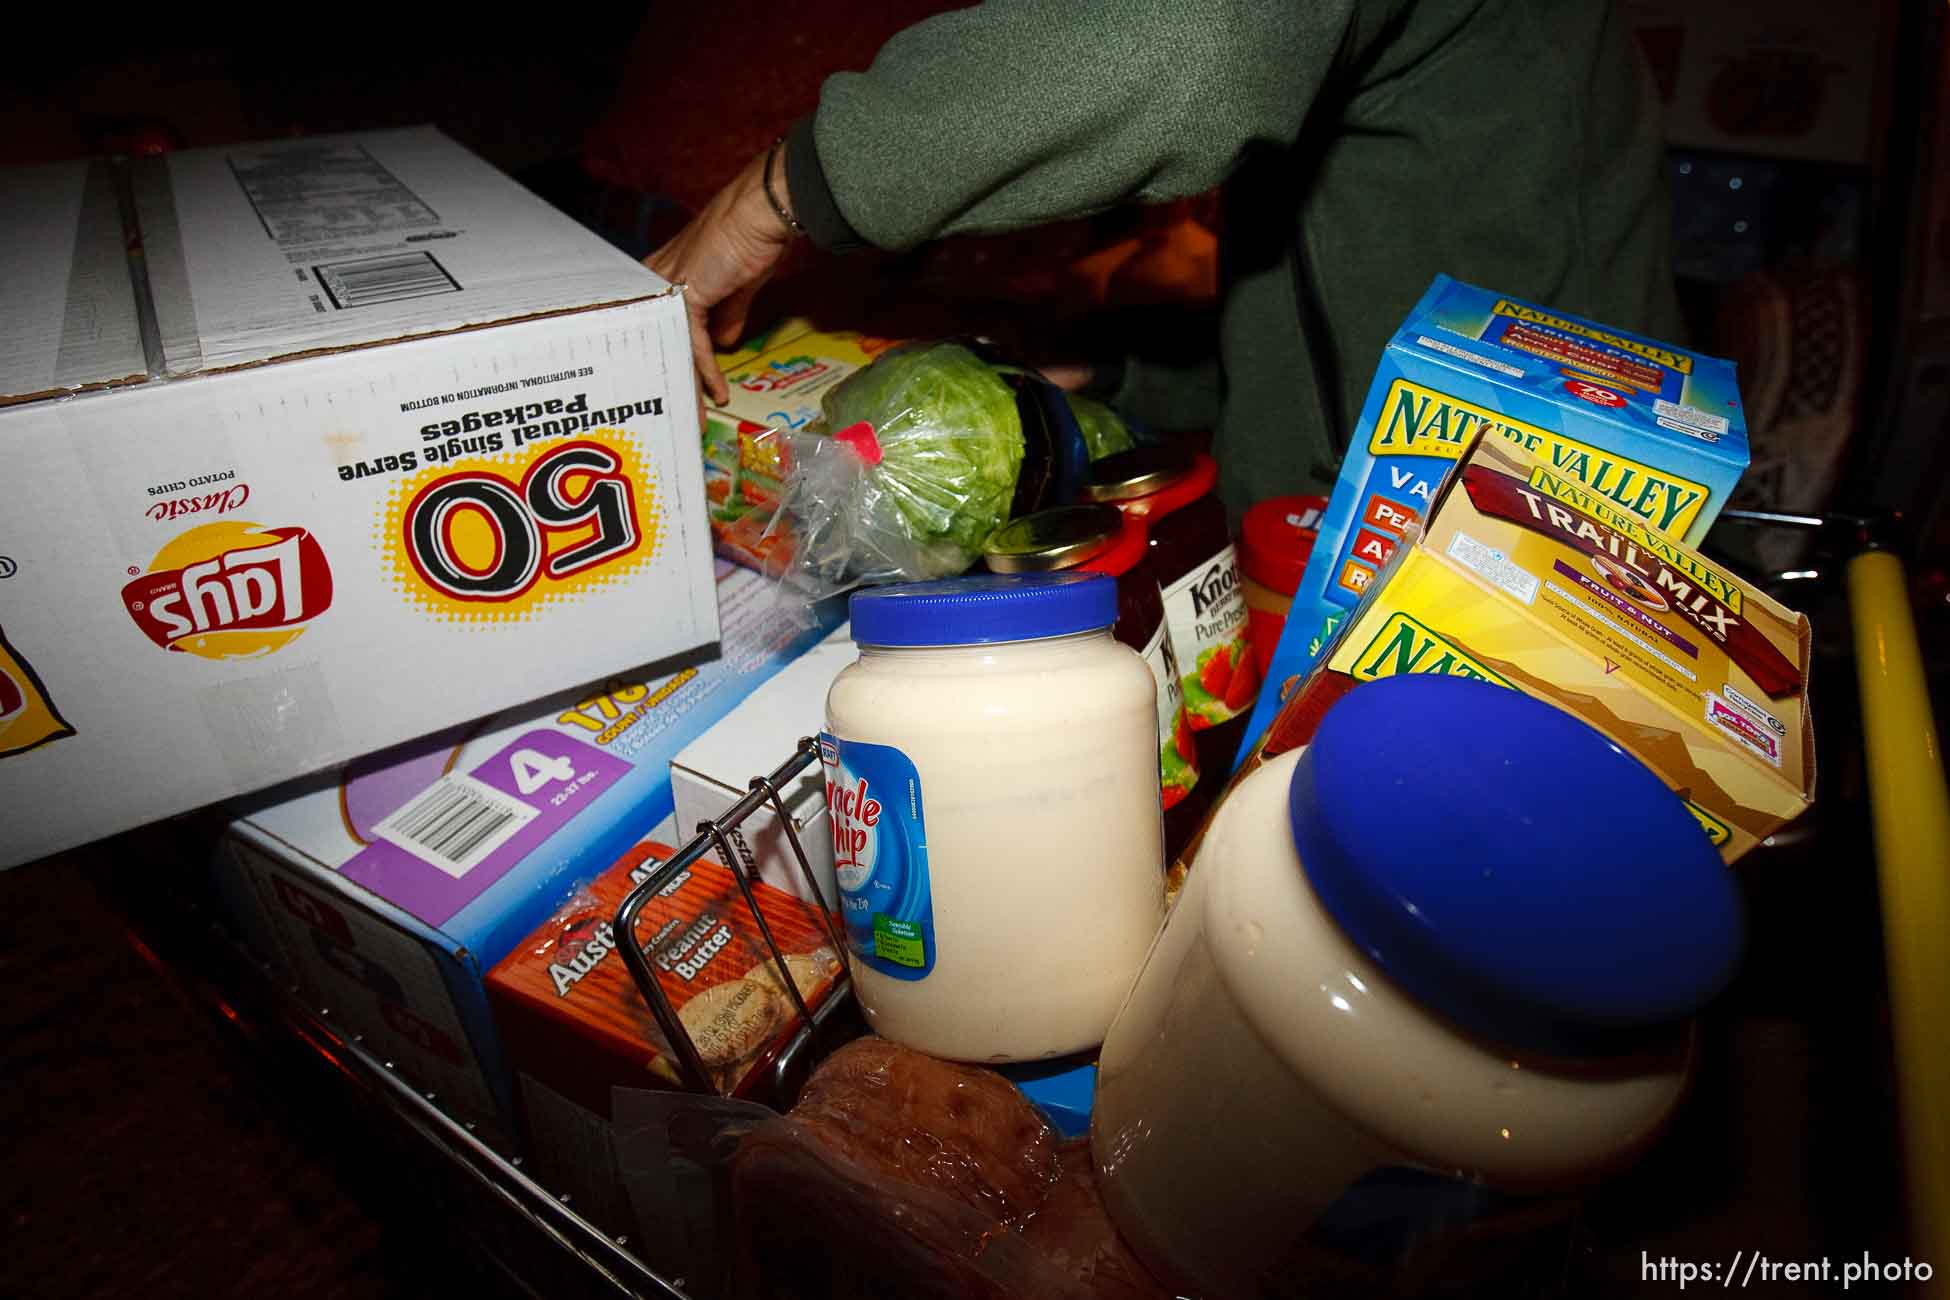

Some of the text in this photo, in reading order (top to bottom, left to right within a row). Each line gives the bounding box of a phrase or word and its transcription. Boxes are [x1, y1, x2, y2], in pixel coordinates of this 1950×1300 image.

[1501, 303, 1588, 335] NATURE
[1600, 329, 1686, 369] VALLEY
[400, 366, 594, 413] SEE NUTRITIONAL INFORMATION ON BOTTOM
[420, 393, 589, 442] Packages
[337, 397, 664, 482] Individual Single Serve
[145, 483, 250, 521] Classic
[147, 470, 236, 496] POTATO CHIPS
[1552, 444, 1699, 531] VALLEY
[403, 440, 642, 602] 50
[1537, 471, 1738, 607] NATURE VALLEY
[1516, 487, 1649, 577] TRAIL
[1656, 566, 1741, 637] MIX
[1193, 619, 1222, 640] Pure
[1579, 575, 1625, 606] FRUIT
[1641, 614, 1673, 637] NUT
[509, 748, 576, 796] 4
[830, 812, 867, 867] hip
[547, 917, 640, 997] Austi
[655, 912, 719, 972] Peanut
[674, 924, 733, 982] Butter
